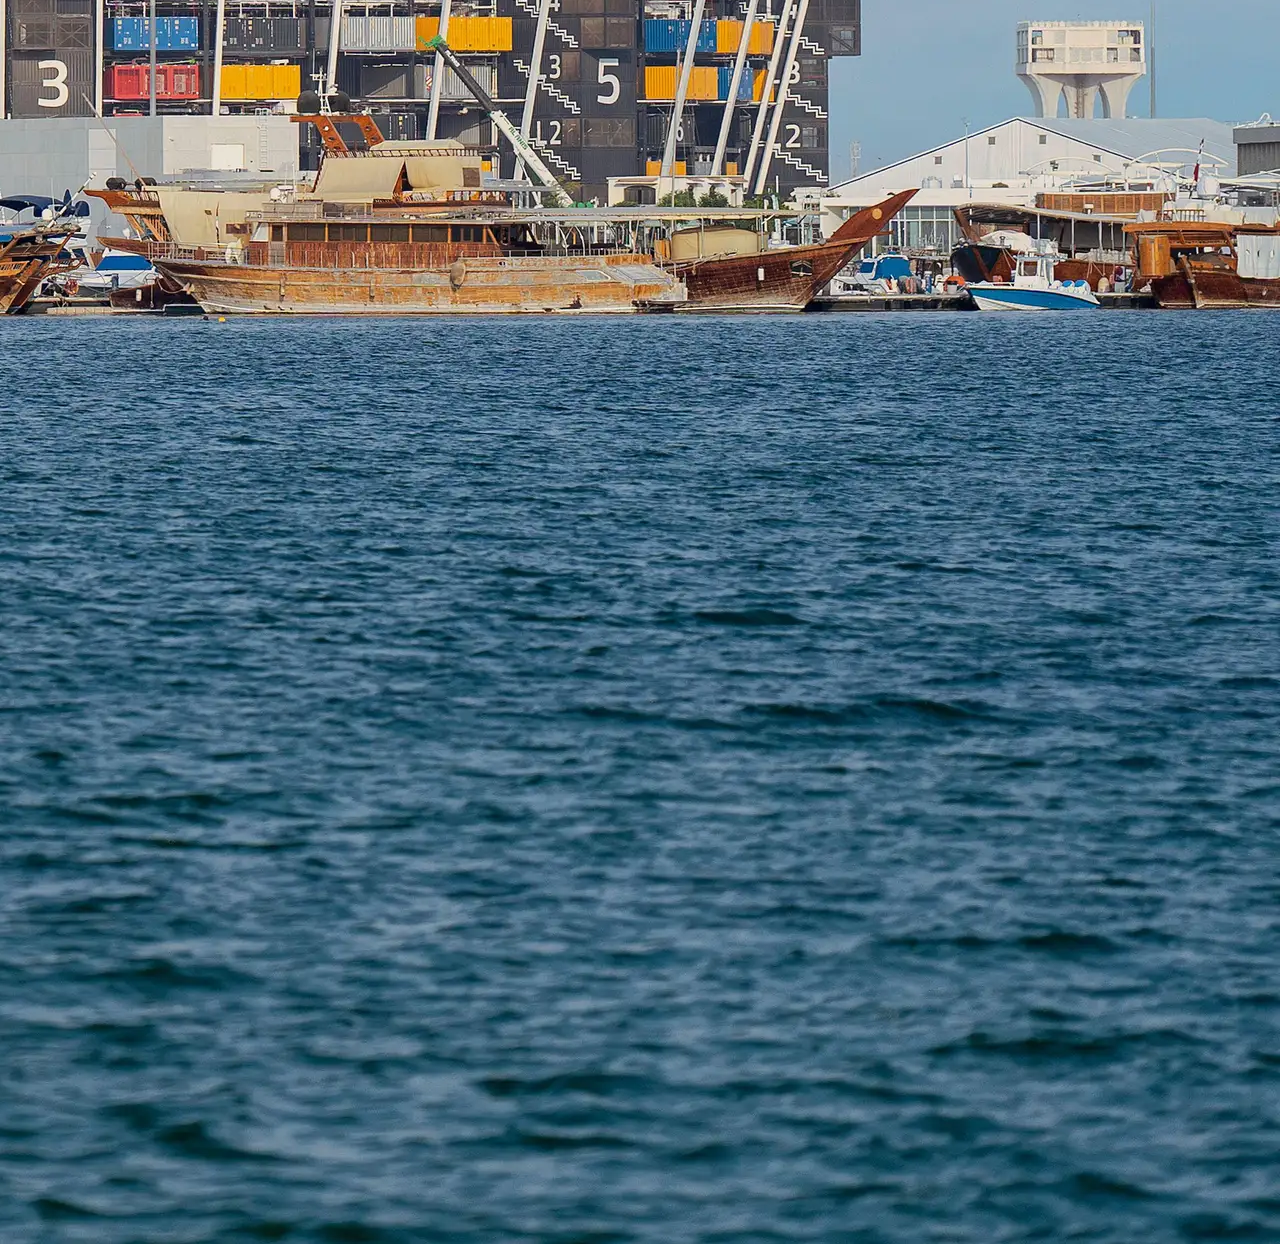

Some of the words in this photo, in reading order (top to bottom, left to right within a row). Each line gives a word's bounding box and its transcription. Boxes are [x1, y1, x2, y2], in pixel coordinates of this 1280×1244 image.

[38, 60, 69, 107] 3
[597, 58, 620, 104] 5
[535, 121, 561, 145] L2
